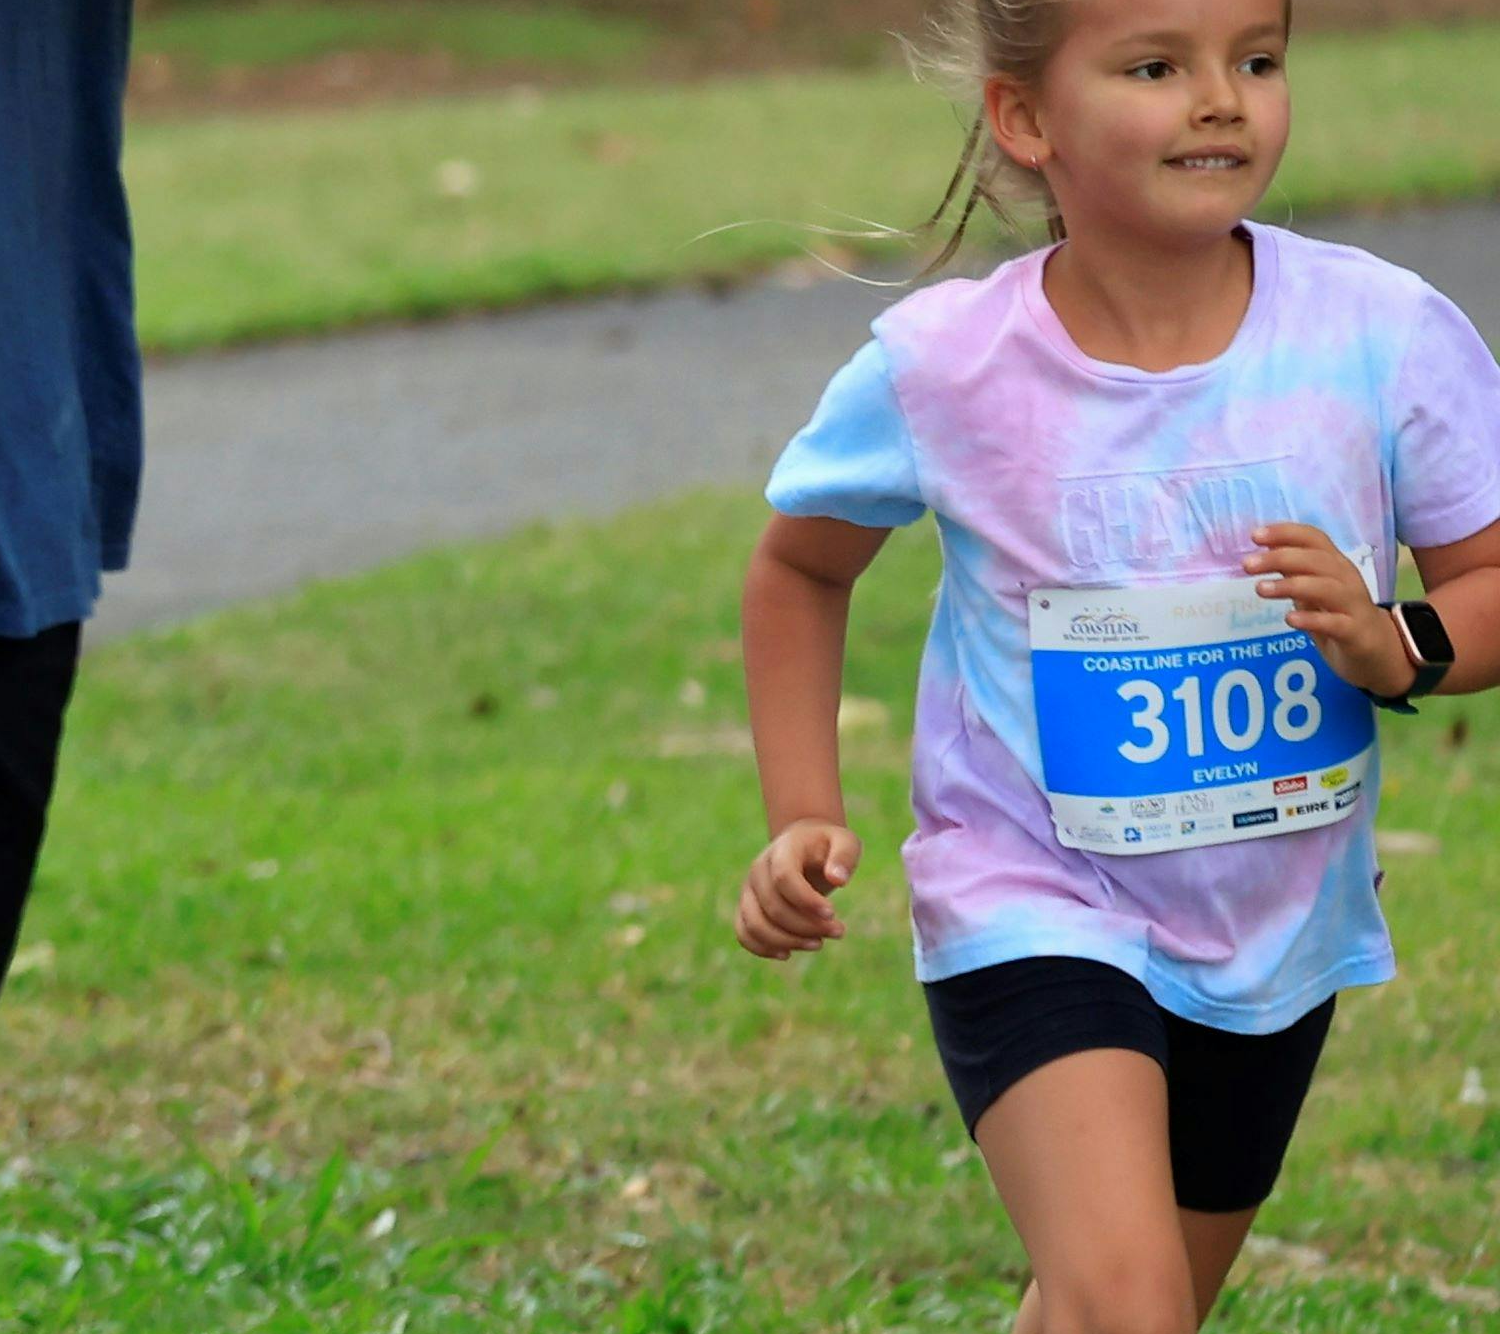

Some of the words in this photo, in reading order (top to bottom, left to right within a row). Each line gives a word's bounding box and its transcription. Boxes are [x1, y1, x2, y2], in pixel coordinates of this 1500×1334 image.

[1070, 621, 1141, 635] COASTLINE
[1083, 653, 1184, 673] COASTLINE
[1188, 649, 1225, 665] FOR
[1229, 642, 1264, 661] THE
[1267, 635, 1308, 656] KIDS
[1116, 659, 1321, 764] 3108
[1192, 760, 1259, 784] EVELYN
[1296, 801, 1329, 816] EIRE
